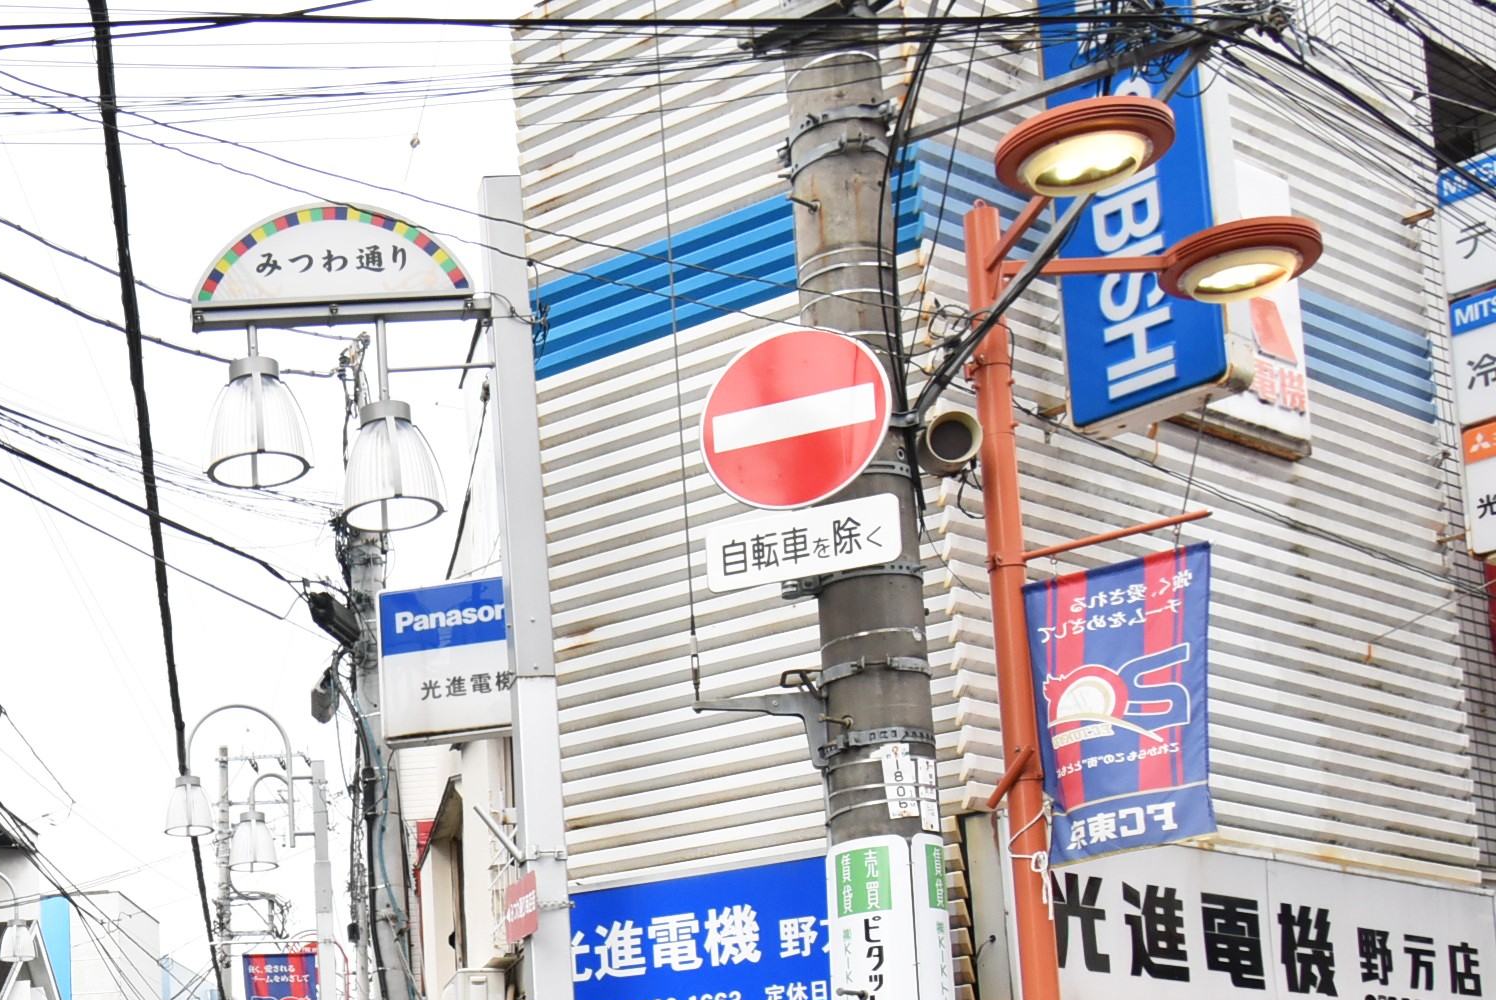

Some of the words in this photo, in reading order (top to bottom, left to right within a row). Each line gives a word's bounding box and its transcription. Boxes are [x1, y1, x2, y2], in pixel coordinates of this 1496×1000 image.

[255, 244, 407, 277] みつわ通り
[721, 516, 883, 577] 自転車を除く
[420, 670, 516, 701] 光進電機
[841, 853, 854, 914] 賃貸
[863, 849, 881, 911] 売買
[932, 847, 945, 908] 賃貸
[1051, 871, 1340, 998] 光進電機
[1356, 926, 1483, 997] 野方店
